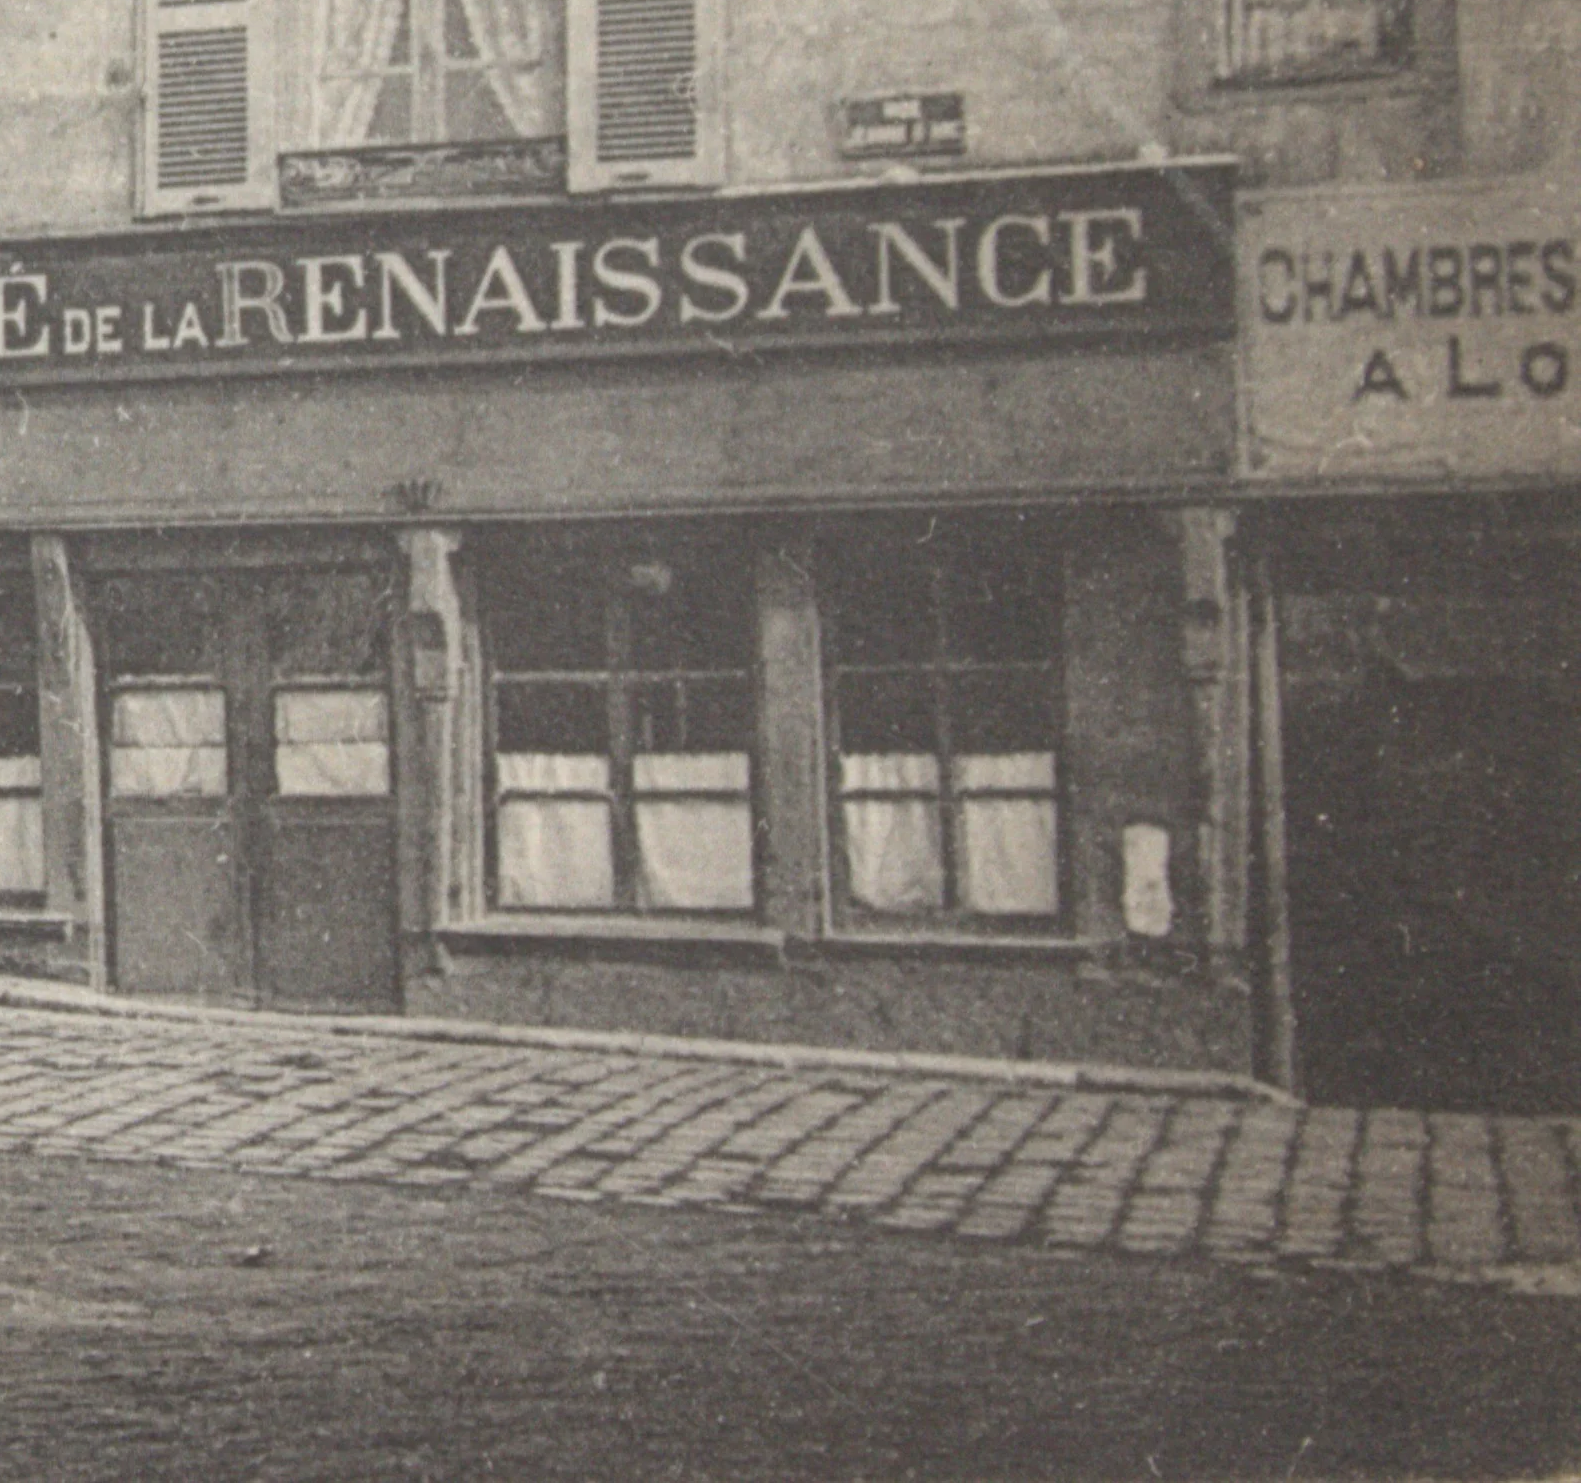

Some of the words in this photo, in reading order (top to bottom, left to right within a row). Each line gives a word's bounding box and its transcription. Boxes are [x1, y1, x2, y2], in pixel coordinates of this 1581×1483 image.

[63, 306, 122, 354] DE
[143, 301, 207, 351] LA
[215, 207, 1150, 349] RENAISSANCE
[1258, 238, 1576, 322] CHAMBRES
